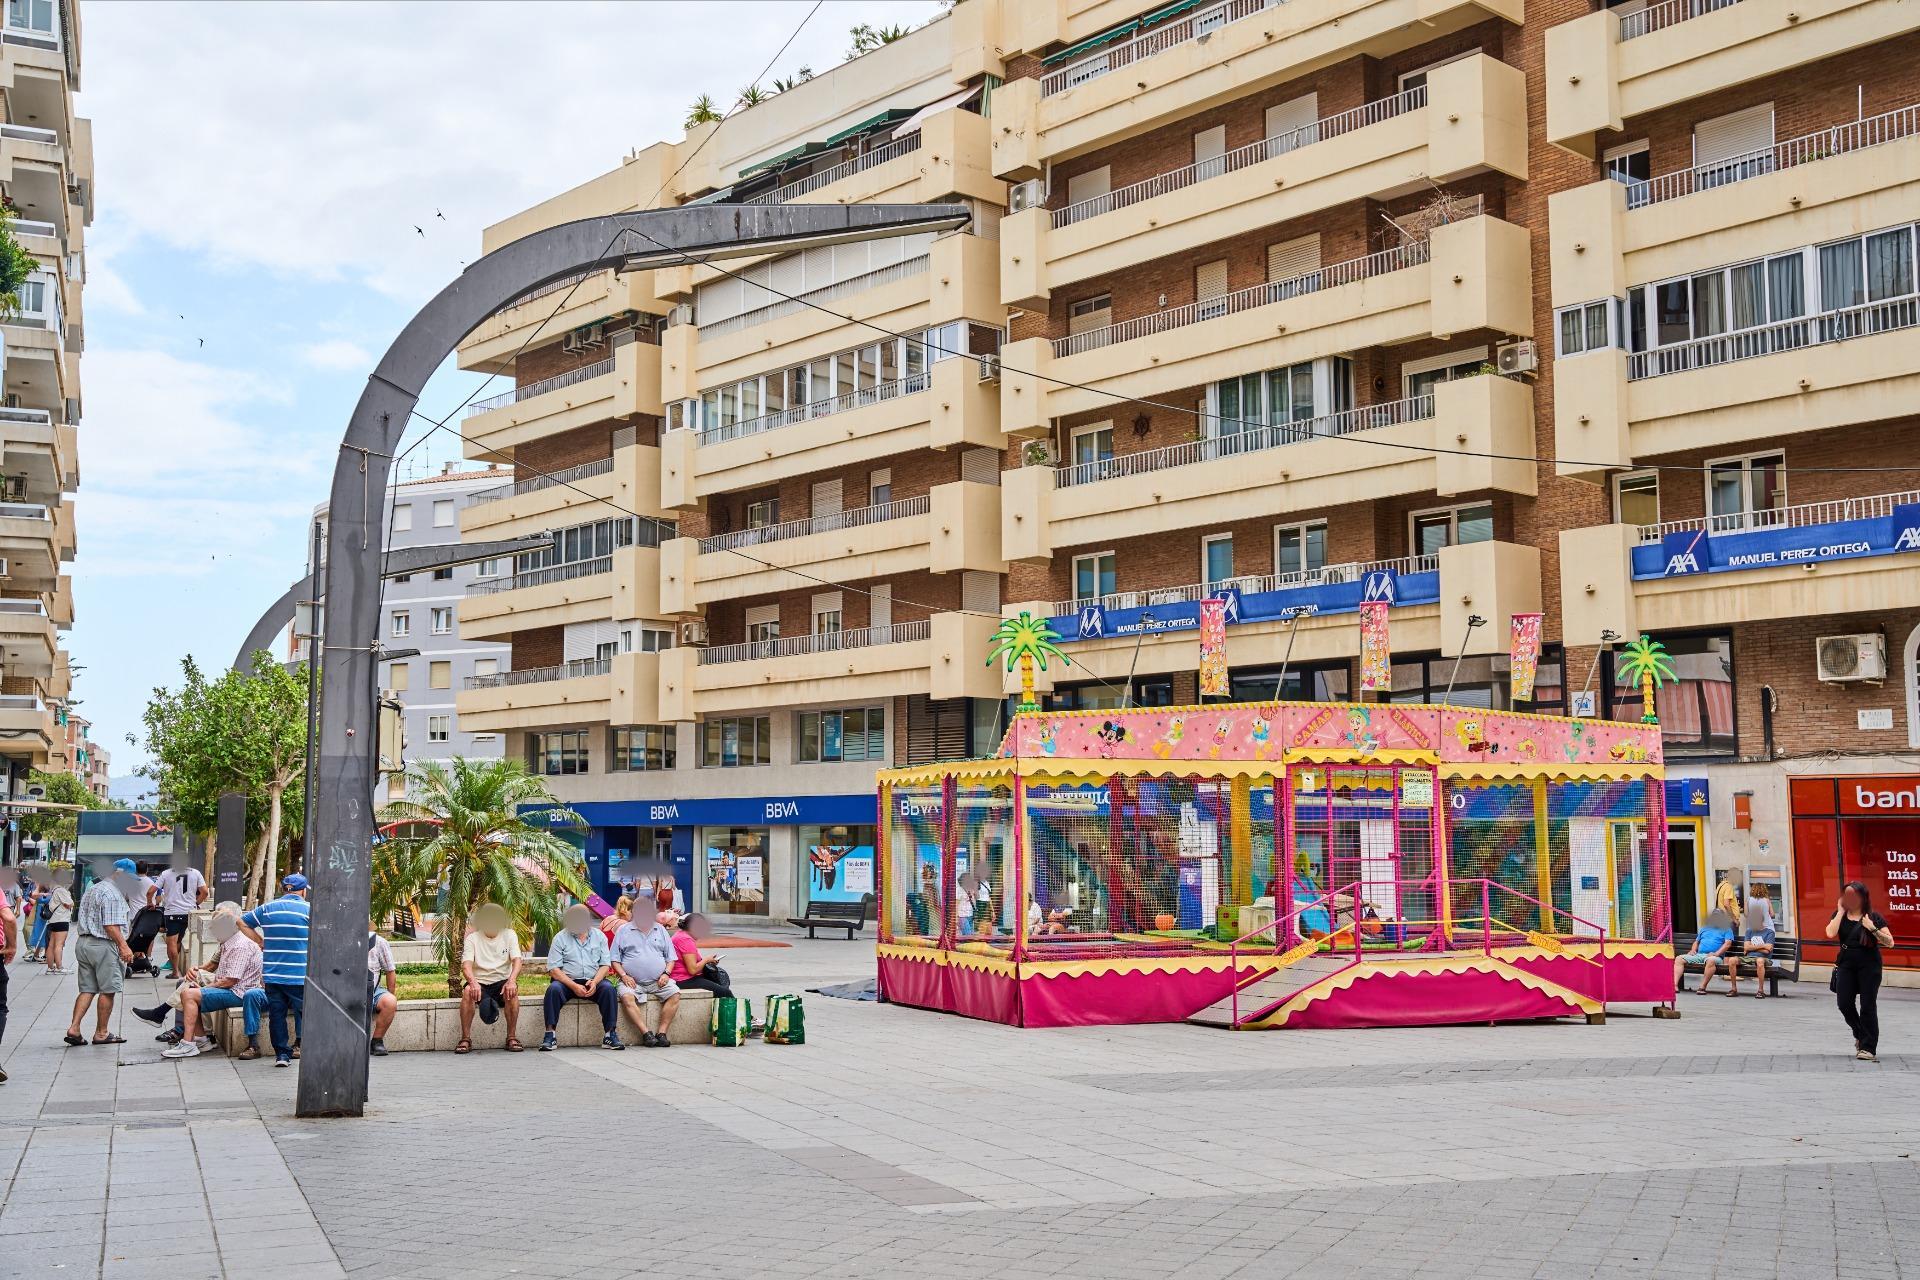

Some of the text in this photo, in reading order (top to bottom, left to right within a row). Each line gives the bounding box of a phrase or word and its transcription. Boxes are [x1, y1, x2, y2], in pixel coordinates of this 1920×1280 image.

[1729, 542, 1871, 566] MANUEL PEREZ ORTEGA
[1665, 552, 1699, 575] AXA
[1117, 618, 1196, 633] MANUEL PEREZ ORTEGA
[1294, 709, 1332, 746] CAMAS
[1856, 785, 1920, 808] ban
[650, 804, 679, 820] BBVA
[766, 801, 799, 818] BBVA
[1886, 851, 1916, 862] Uno
[1888, 868, 1918, 880] más
[1889, 885, 1911, 897] del
